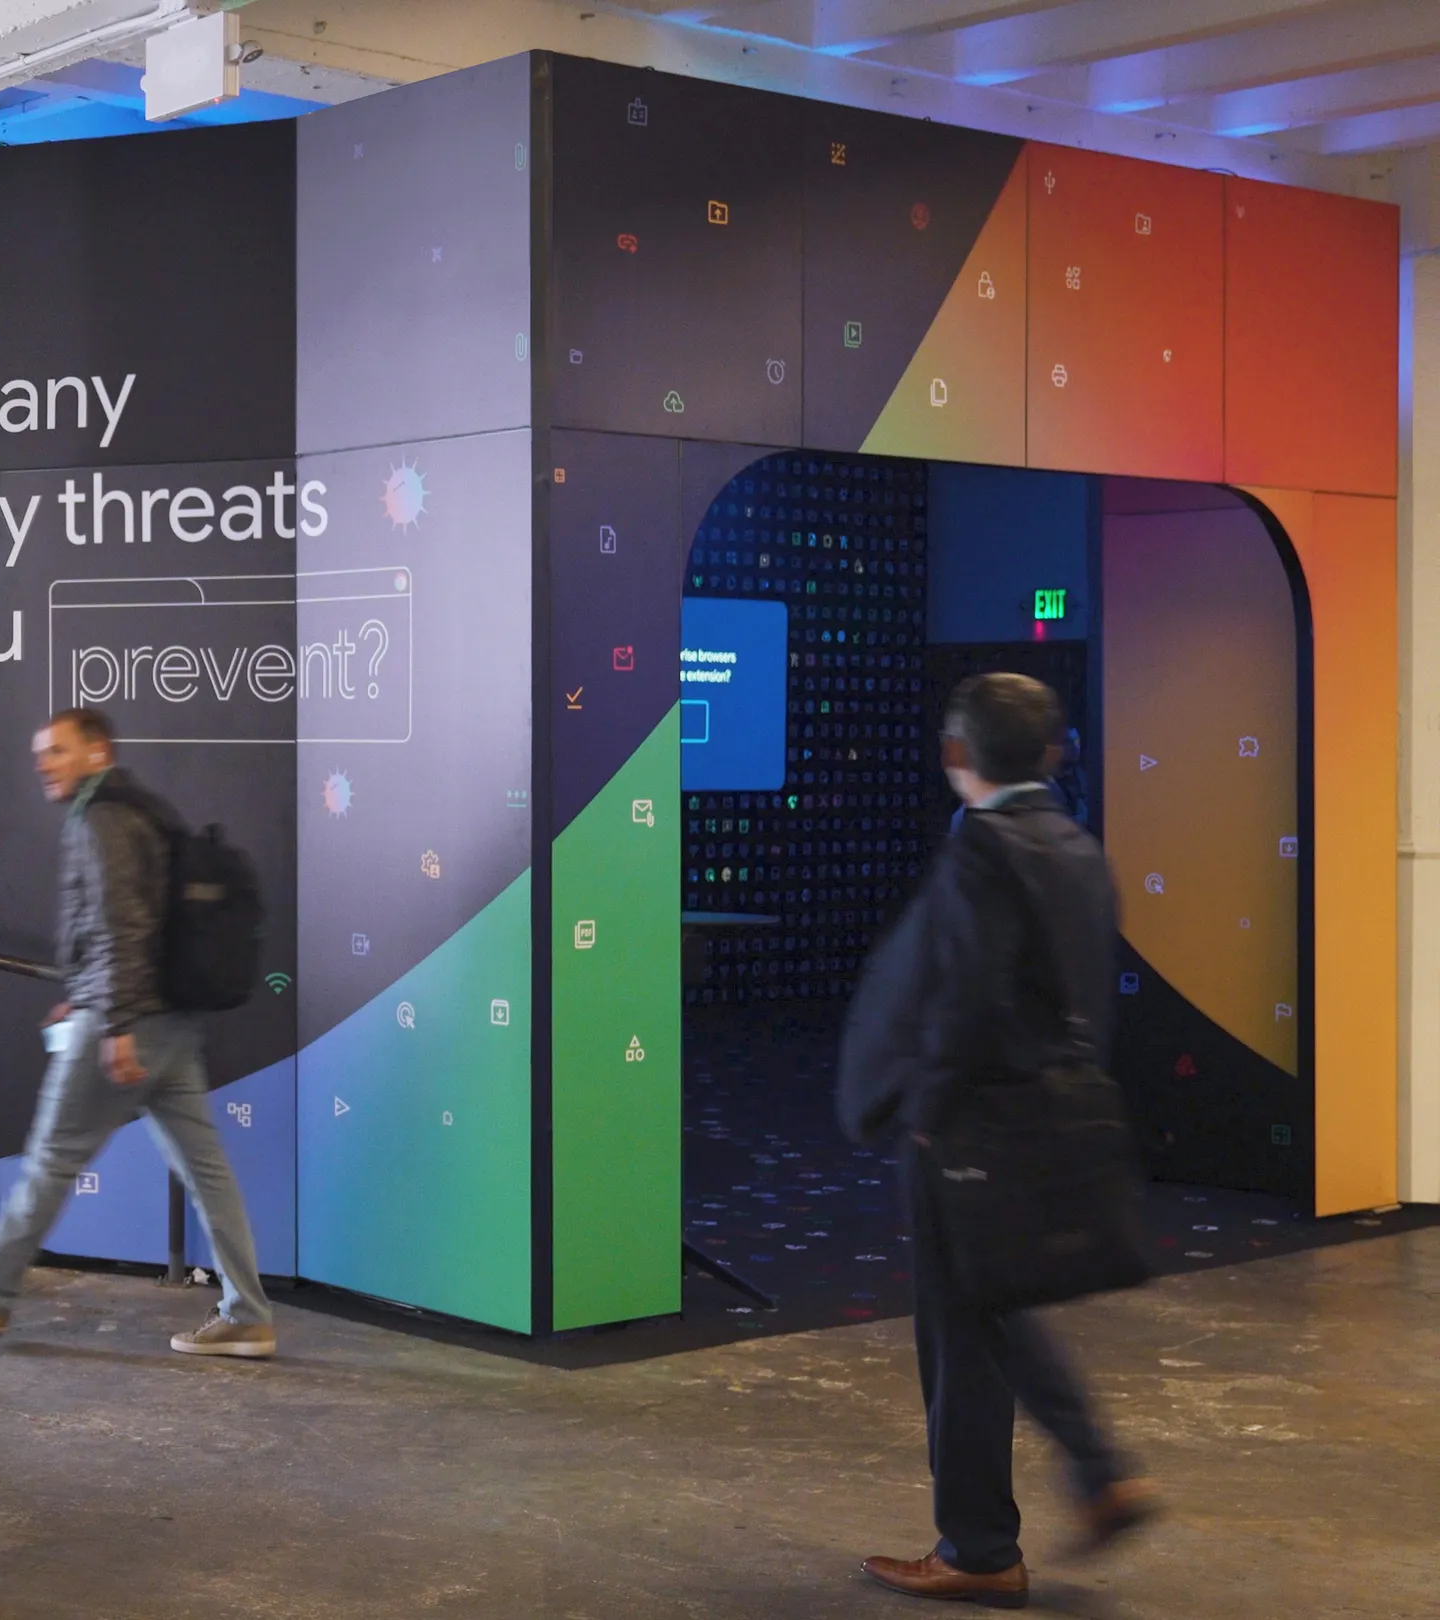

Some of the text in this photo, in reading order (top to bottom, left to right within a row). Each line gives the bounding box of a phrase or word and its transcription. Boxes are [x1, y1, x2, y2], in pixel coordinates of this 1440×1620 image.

[57, 471, 329, 546] threats
[1034, 589, 1066, 619] EXIT
[71, 619, 390, 707] prevent?
[698, 648, 737, 664] browsers
[686, 669, 731, 683] extension?
